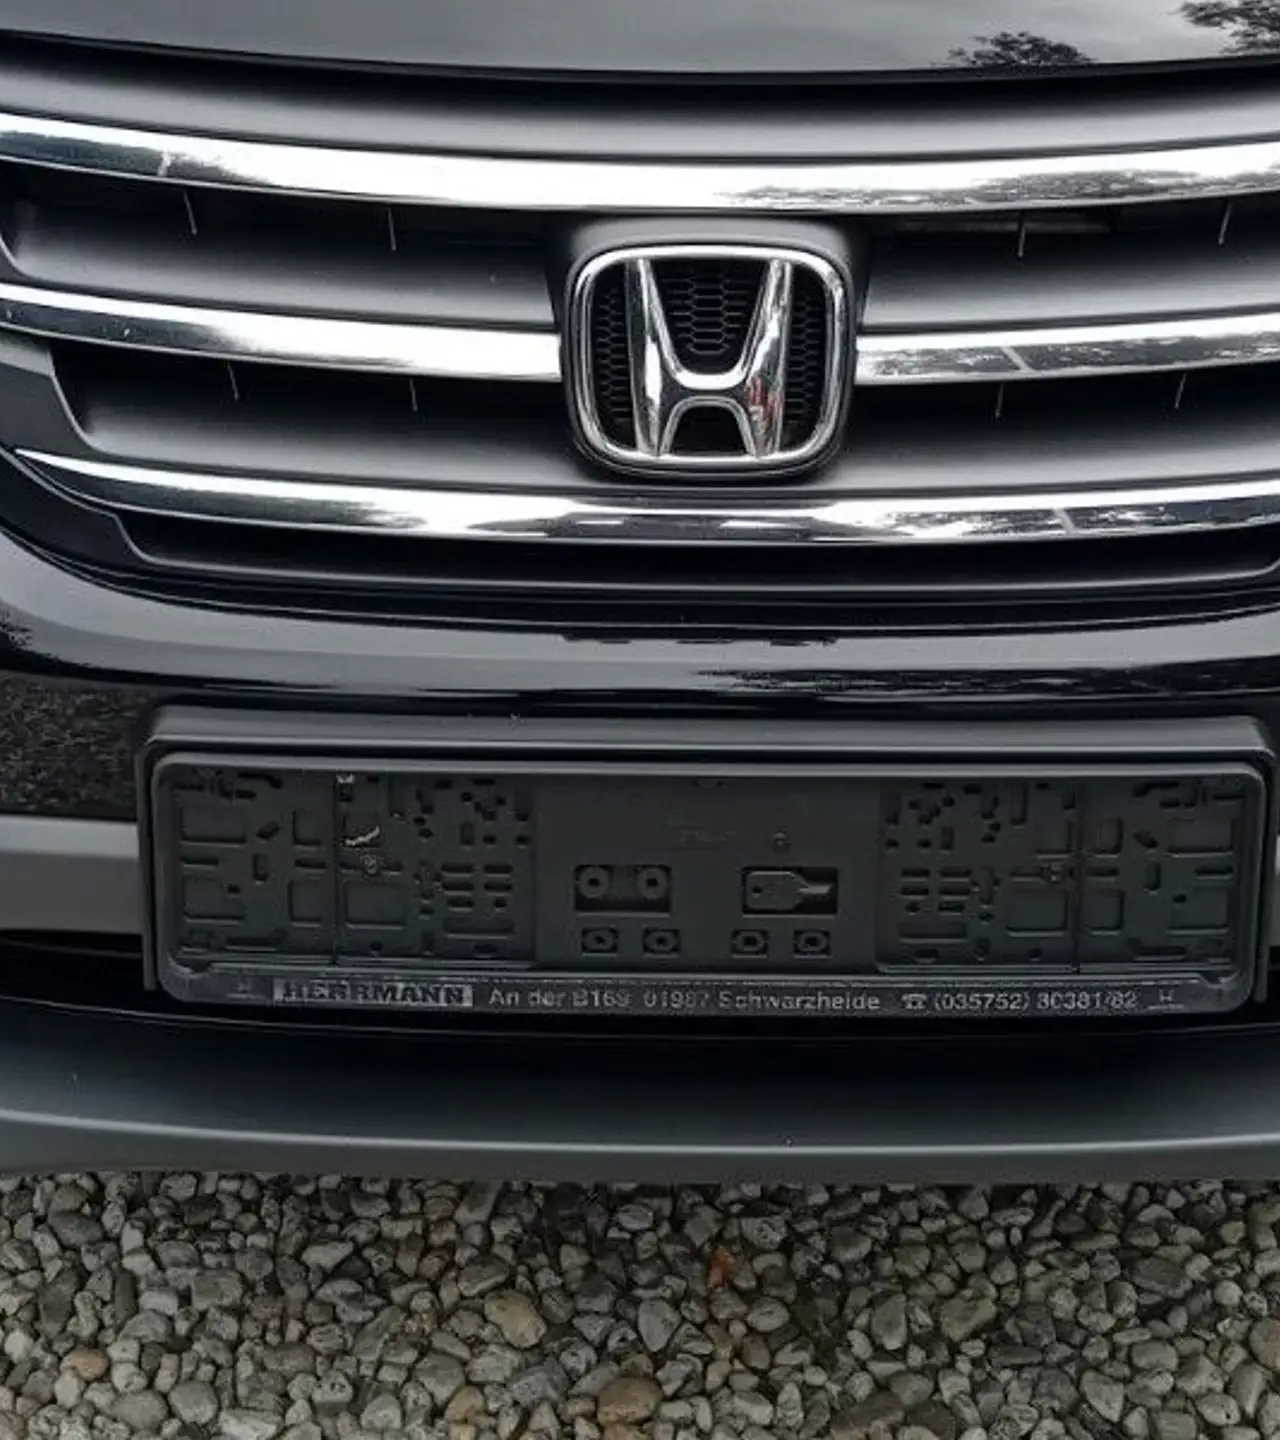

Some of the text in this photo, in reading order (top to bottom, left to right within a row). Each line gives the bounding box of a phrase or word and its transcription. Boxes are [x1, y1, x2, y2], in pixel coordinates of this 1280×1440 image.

[280, 979, 467, 1005] HERRMANN
[488, 987, 521, 1006] An
[527, 987, 567, 1007] der
